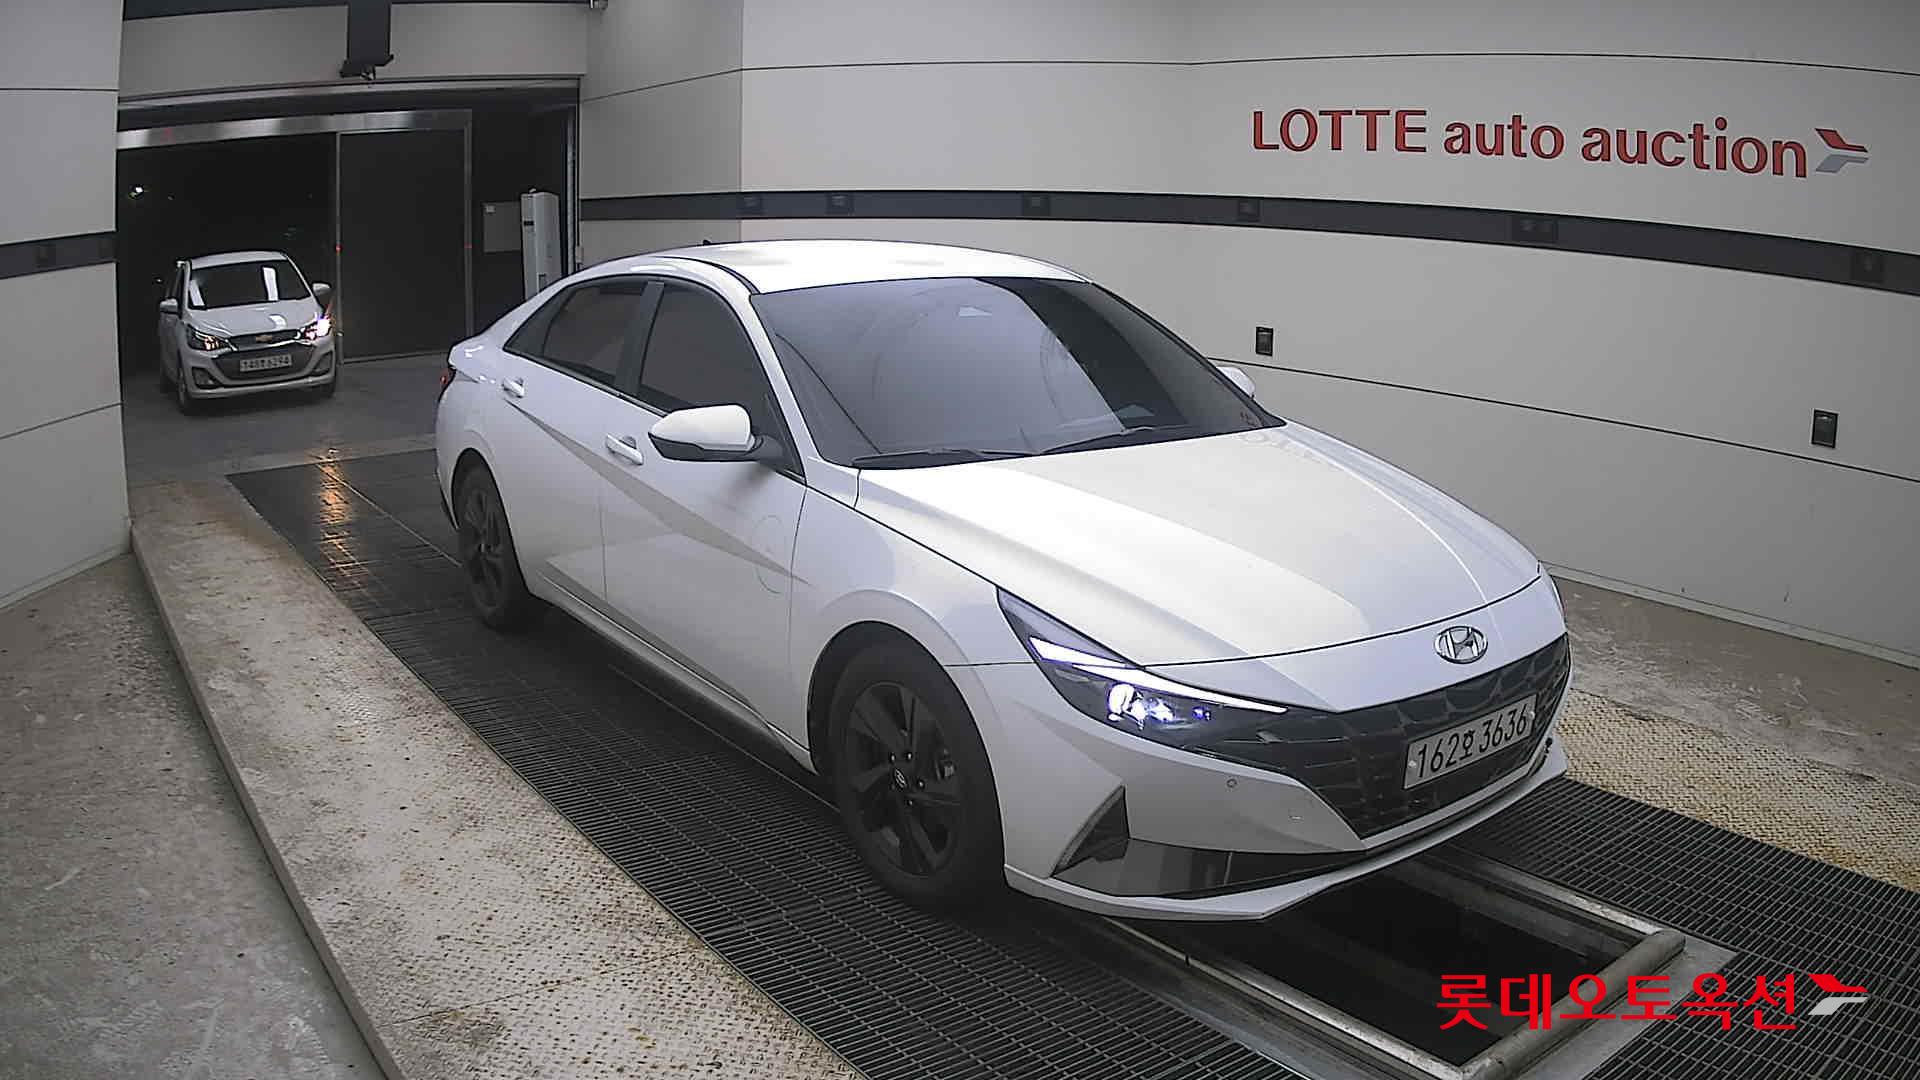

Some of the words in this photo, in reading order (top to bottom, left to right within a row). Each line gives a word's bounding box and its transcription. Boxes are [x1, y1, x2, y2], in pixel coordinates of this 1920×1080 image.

[1252, 109, 1427, 152] LOTTE
[1443, 114, 1565, 159] auto
[1581, 116, 1807, 178] auction
[1479, 703, 1528, 753] 3636
